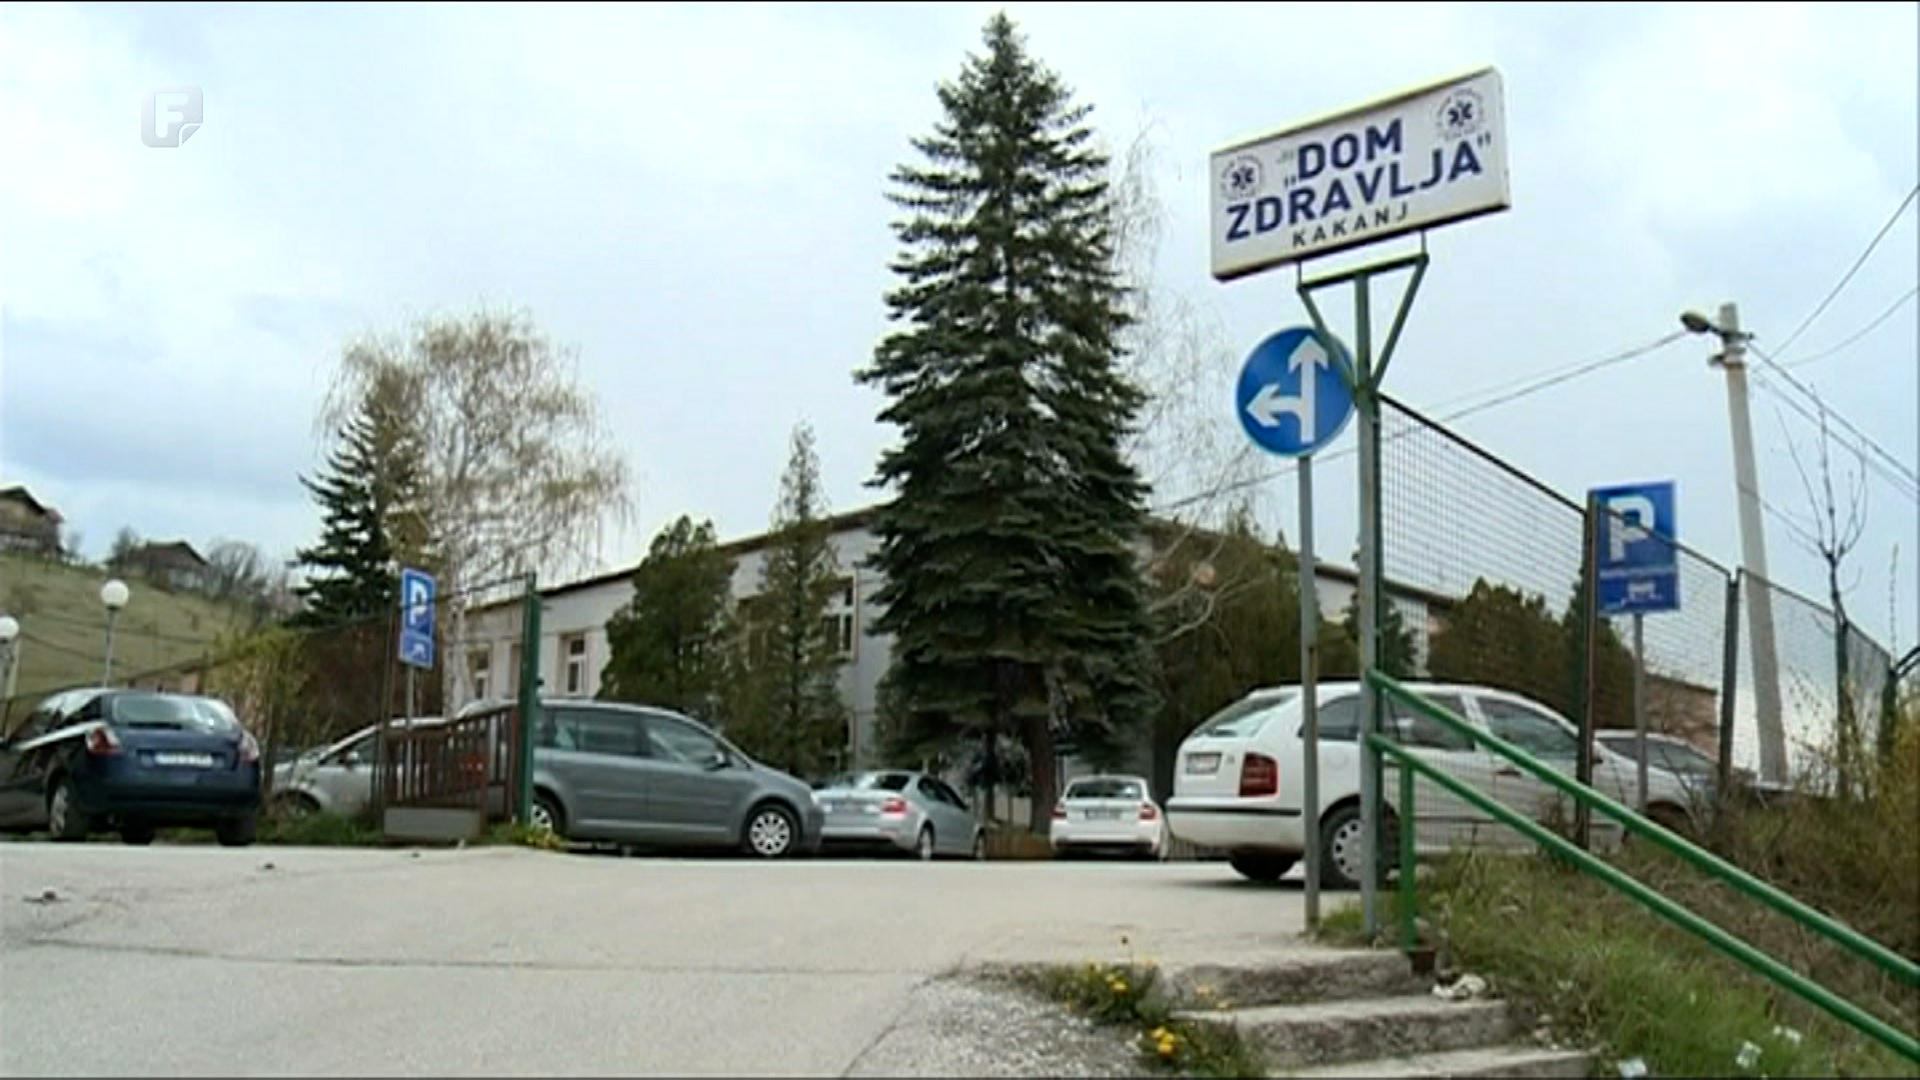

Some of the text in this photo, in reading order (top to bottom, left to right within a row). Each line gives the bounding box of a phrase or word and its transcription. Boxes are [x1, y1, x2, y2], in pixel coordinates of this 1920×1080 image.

[1292, 203, 1408, 248] KAKANJ
[1607, 495, 1655, 562] P
[410, 579, 428, 626] P
